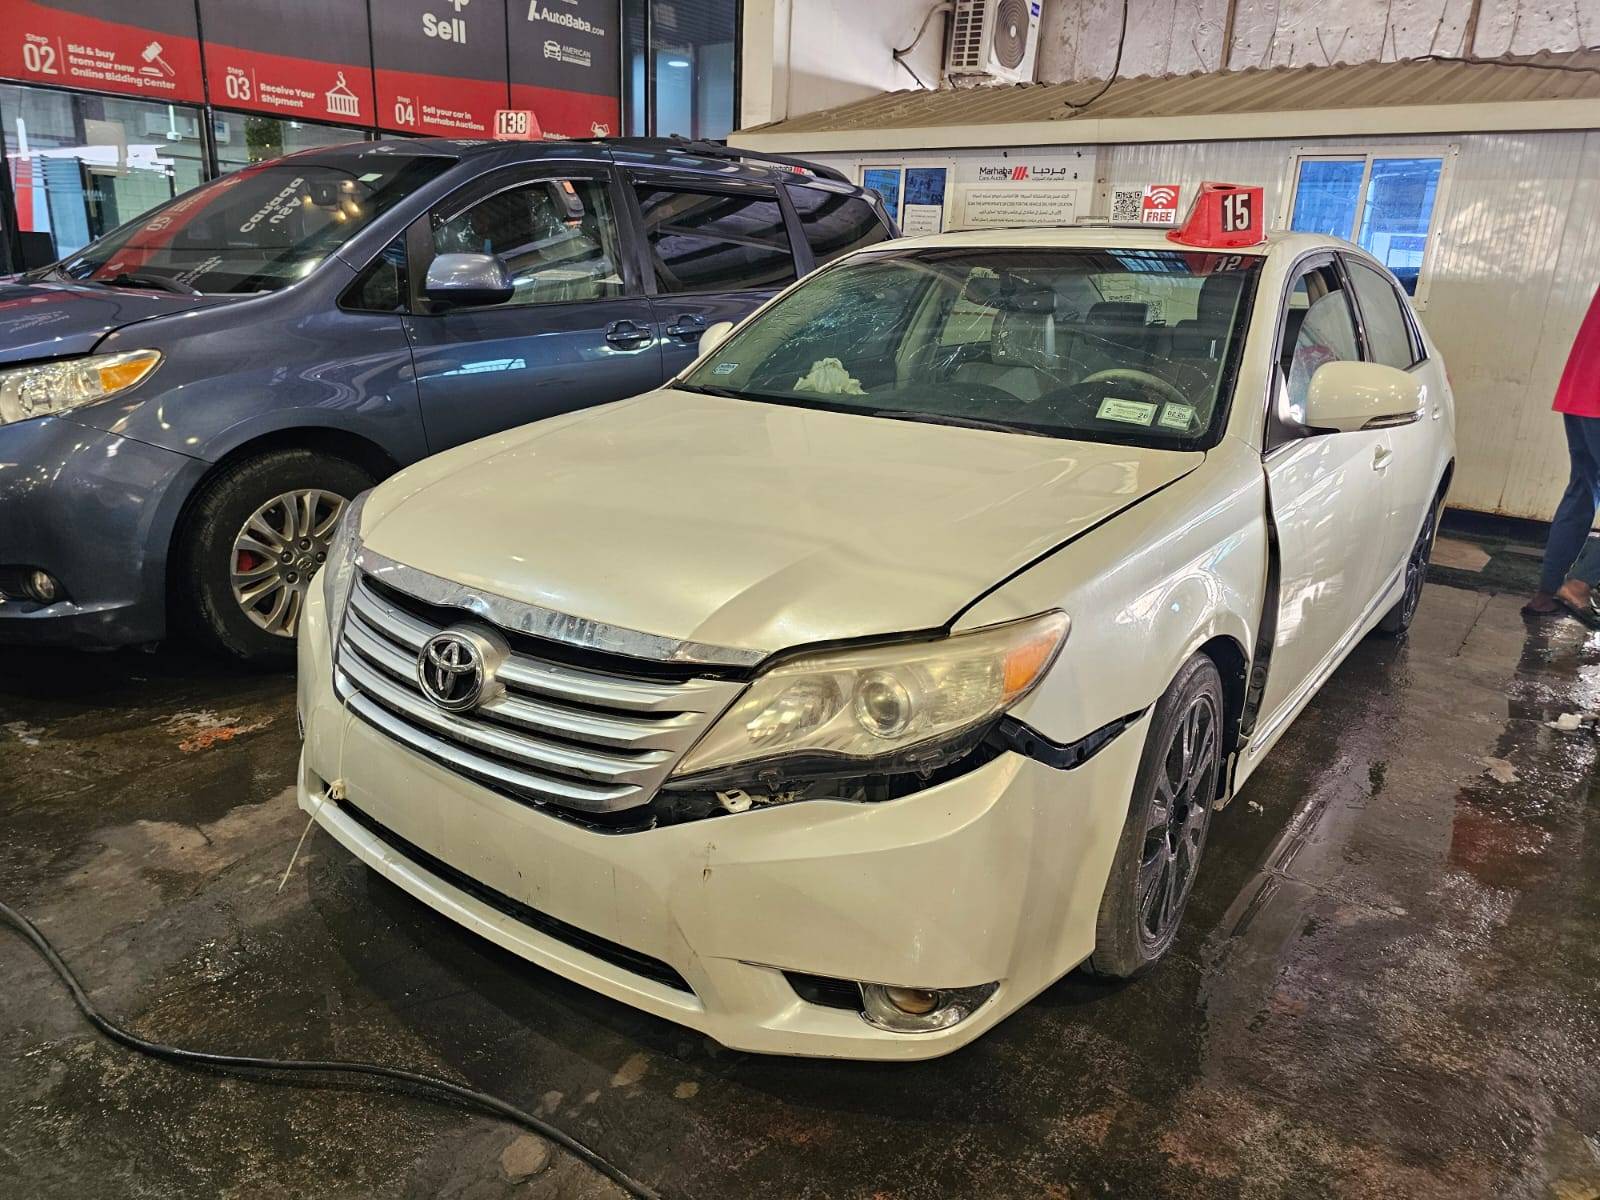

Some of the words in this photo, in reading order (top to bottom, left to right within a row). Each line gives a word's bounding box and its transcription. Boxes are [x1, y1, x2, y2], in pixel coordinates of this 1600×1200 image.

[422, 12, 467, 44] Sell
[25, 33, 48, 45] Step
[23, 43, 58, 75] 02
[67, 44, 85, 54] Bid
[86, 46, 94, 55] &
[95, 47, 115, 61] buy
[69, 55, 94, 67] from
[96, 61, 113, 70] our
[114, 63, 135, 73] new
[227, 66, 244, 76] Step
[71, 67, 104, 79] Online
[105, 72, 143, 87] Bidding
[144, 76, 176, 90] Center
[226, 74, 251, 101] 03
[260, 83, 295, 96] Receive
[295, 88, 316, 99] Your
[261, 94, 304, 107] Shipment
[394, 103, 416, 126] 04
[422, 105, 436, 115] Sell
[436, 108, 453, 118] your
[453, 111, 465, 119] car
[465, 110, 472, 120] in
[423, 115, 455, 127] Marhaba
[455, 120, 485, 131] Auctions
[500, 112, 527, 134] 138
[979, 166, 1012, 175] Marhaba
[1032, 166, 1066, 176] مرحبا
[1146, 211, 1172, 222] FREE
[1224, 193, 1249, 232] 15
